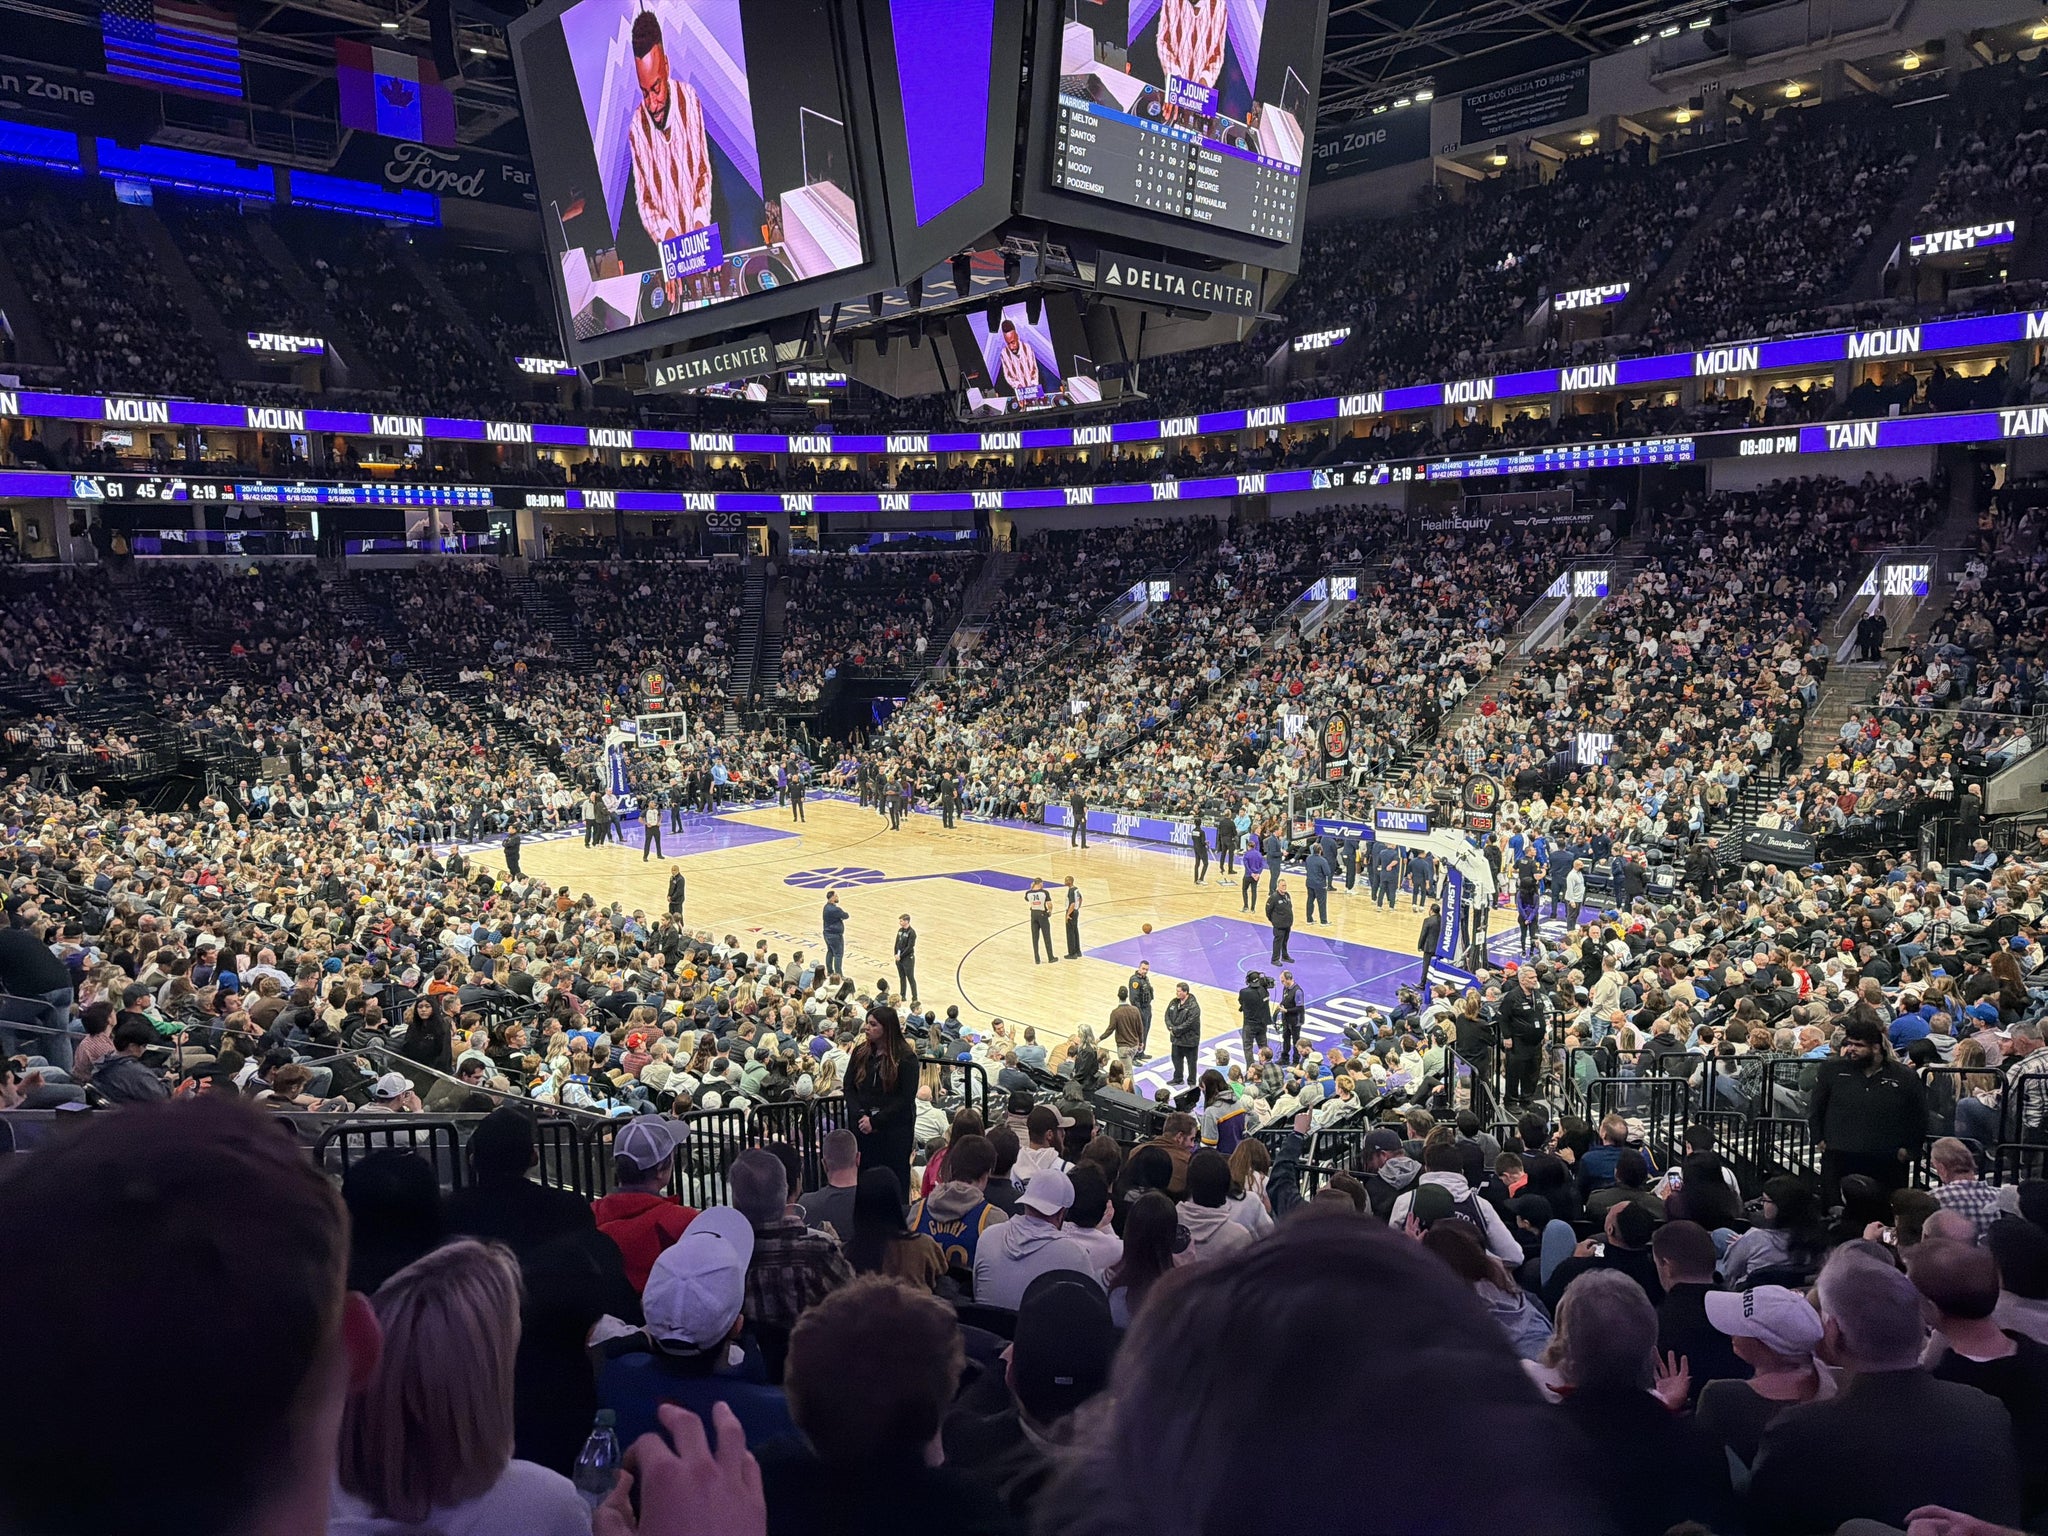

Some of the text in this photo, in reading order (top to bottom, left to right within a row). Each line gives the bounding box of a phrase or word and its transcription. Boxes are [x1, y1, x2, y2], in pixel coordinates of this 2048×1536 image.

[26, 75, 94, 106] Zone
[1171, 78, 1209, 103] DJ JOUNE
[1466, 94, 1487, 106] TEXT
[1507, 82, 1534, 96] DELTA
[1535, 78, 1547, 88] TO
[1059, 94, 1090, 111] WARRIORS
[1060, 125, 1066, 134] 15
[1070, 128, 1096, 142] SANTOS
[1062, 109, 1066, 117] 8
[1072, 112, 1098, 127] MELTON
[1171, 142, 1177, 151] 12
[1190, 135, 1202, 146] JAZZ
[1343, 128, 1387, 152] Zone
[1058, 142, 1065, 151] 21
[1069, 145, 1086, 157] POST
[1200, 151, 1222, 163] COLLIER
[384, 143, 485, 197] Ford
[1058, 158, 1063, 167] 4
[1068, 161, 1092, 175] MOODY
[1135, 179, 1141, 188] 13
[1188, 162, 1196, 170] 30
[1057, 175, 1062, 183] 2
[1067, 177, 1104, 193] PODZIEMSKI
[1197, 180, 1219, 192] GEORGE
[1194, 209, 1212, 220] BAILEY
[664, 231, 710, 263] DJ JOUNE
[1127, 267, 1252, 307] DELTA CENTER
[666, 346, 768, 382] DELTA CENTER
[105, 400, 168, 422] MOUN
[248, 408, 303, 430] MOUN
[373, 416, 422, 436] MOUN
[487, 423, 531, 442] MOUN
[589, 429, 632, 447] MOUN
[691, 434, 733, 451] MOUN
[789, 437, 831, 453] MOUN
[887, 436, 927, 452] MOUN
[981, 433, 1020, 450] MOUN
[1074, 427, 1111, 444] MOUN
[1161, 418, 1197, 437] MOUN
[1247, 407, 1285, 428] MOUN
[1339, 394, 1382, 416] MOUN
[1445, 380, 1492, 404] MOUN
[1562, 365, 1615, 390] MOUN
[1696, 347, 1758, 375] MOUN
[1849, 328, 1919, 358] MOUN
[1740, 436, 1796, 456] 08:00 PM
[582, 422, 1877, 510] TAIN TAIN TAIN TAIN TAIN TAIN TAIN TAIN TAIN
[1334, 467, 1412, 486] 61 45 2:19
[107, 482, 216, 499] 61 45 2:19
[526, 494, 564, 507] 08:00 PM
[706, 512, 741, 526] G2G
[1421, 518, 1491, 532] HealthEquity
[1883, 580, 1913, 595] AIN
[650, 682, 662, 694] 15
[1476, 794, 1488, 806] 15
[1062, 816, 1074, 827] TAI
[1112, 823, 1129, 835] TAIN
[1117, 815, 1140, 828] MOUN
[1175, 823, 1194, 835] MOU
[1170, 832, 1188, 845] TAIN
[1768, 836, 1805, 850] Travelpass
[762, 930, 818, 948] DELTA
[1443, 912, 1454, 952] AMERICA
[929, 1220, 968, 1237] CURRY
